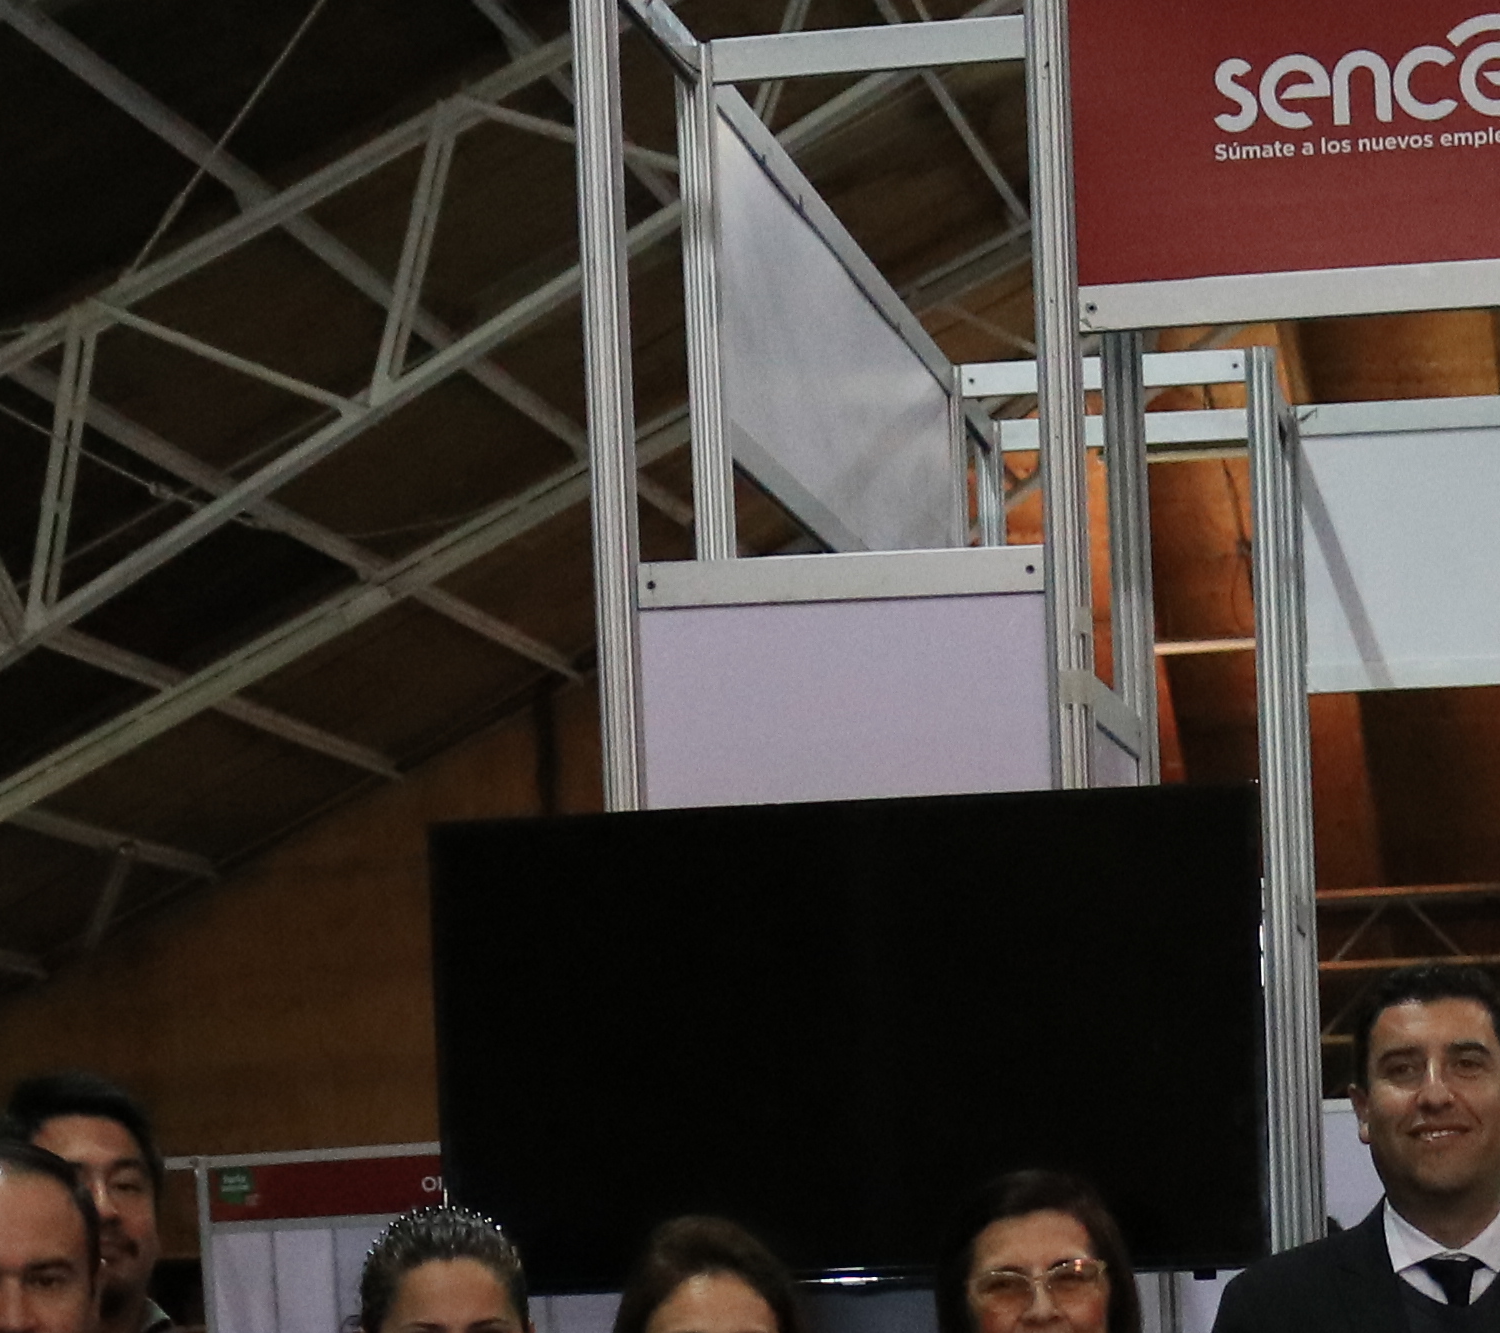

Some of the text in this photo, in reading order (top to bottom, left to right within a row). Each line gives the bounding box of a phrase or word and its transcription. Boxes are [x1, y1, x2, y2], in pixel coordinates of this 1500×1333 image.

[1214, 141, 1295, 162] Súmate
[1301, 141, 1315, 156] a
[1321, 136, 1352, 155] los
[1358, 132, 1434, 152] nuevos
